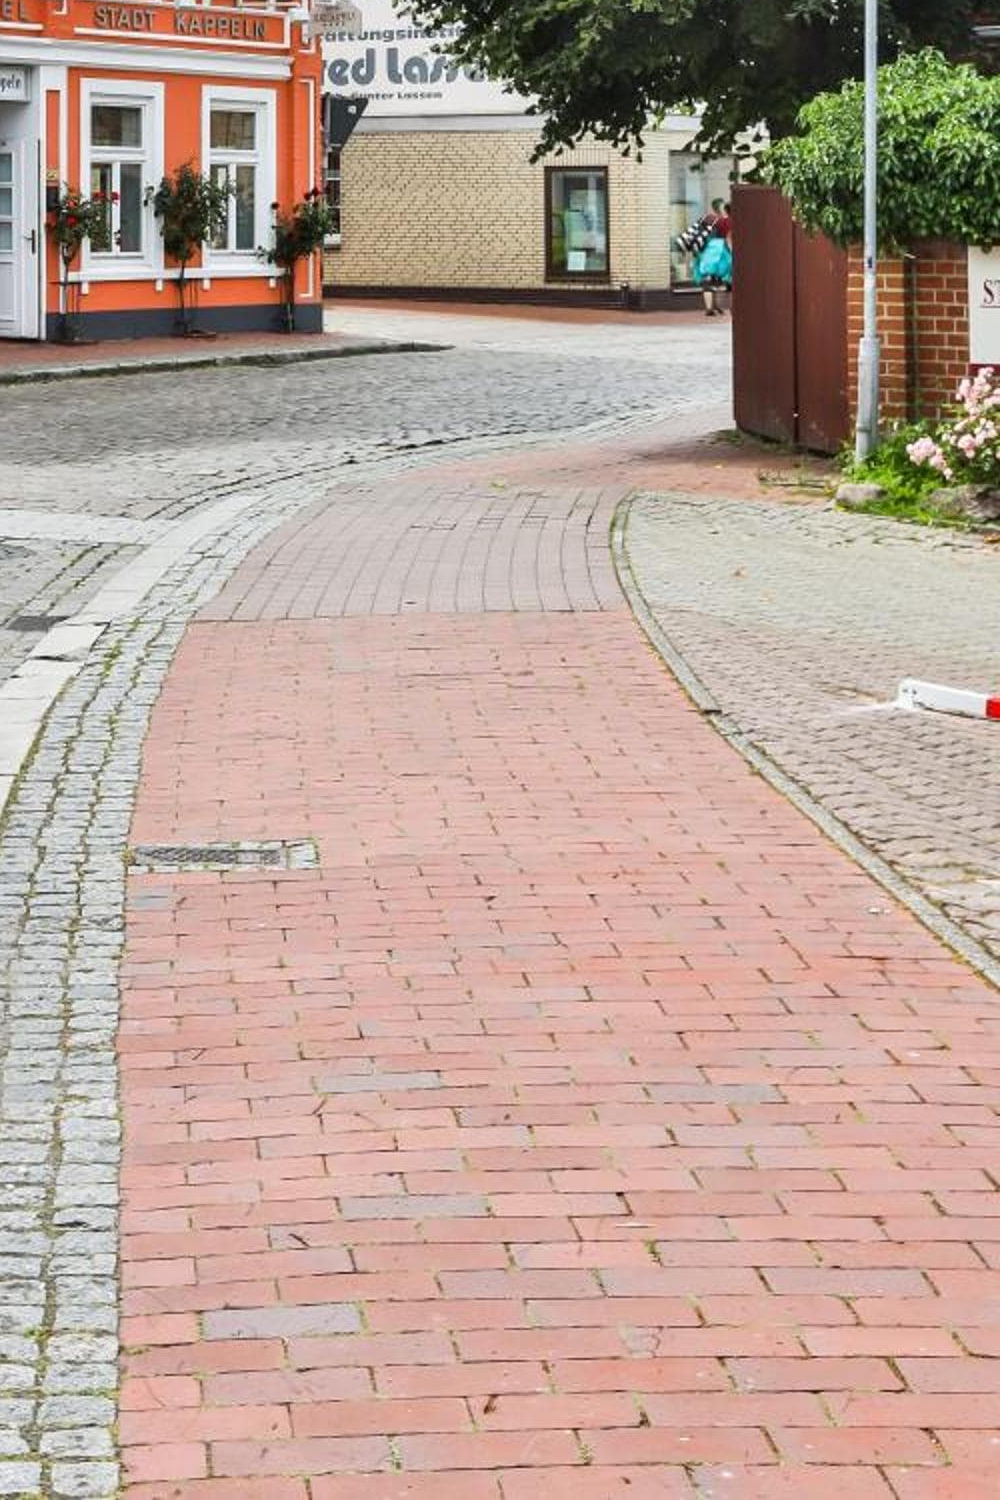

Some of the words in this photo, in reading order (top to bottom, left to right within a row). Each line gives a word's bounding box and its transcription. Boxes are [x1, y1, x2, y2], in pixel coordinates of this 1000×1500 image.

[95, 4, 156, 31] STADT
[175, 12, 268, 41] KAPPELN
[321, 47, 376, 86] ed
